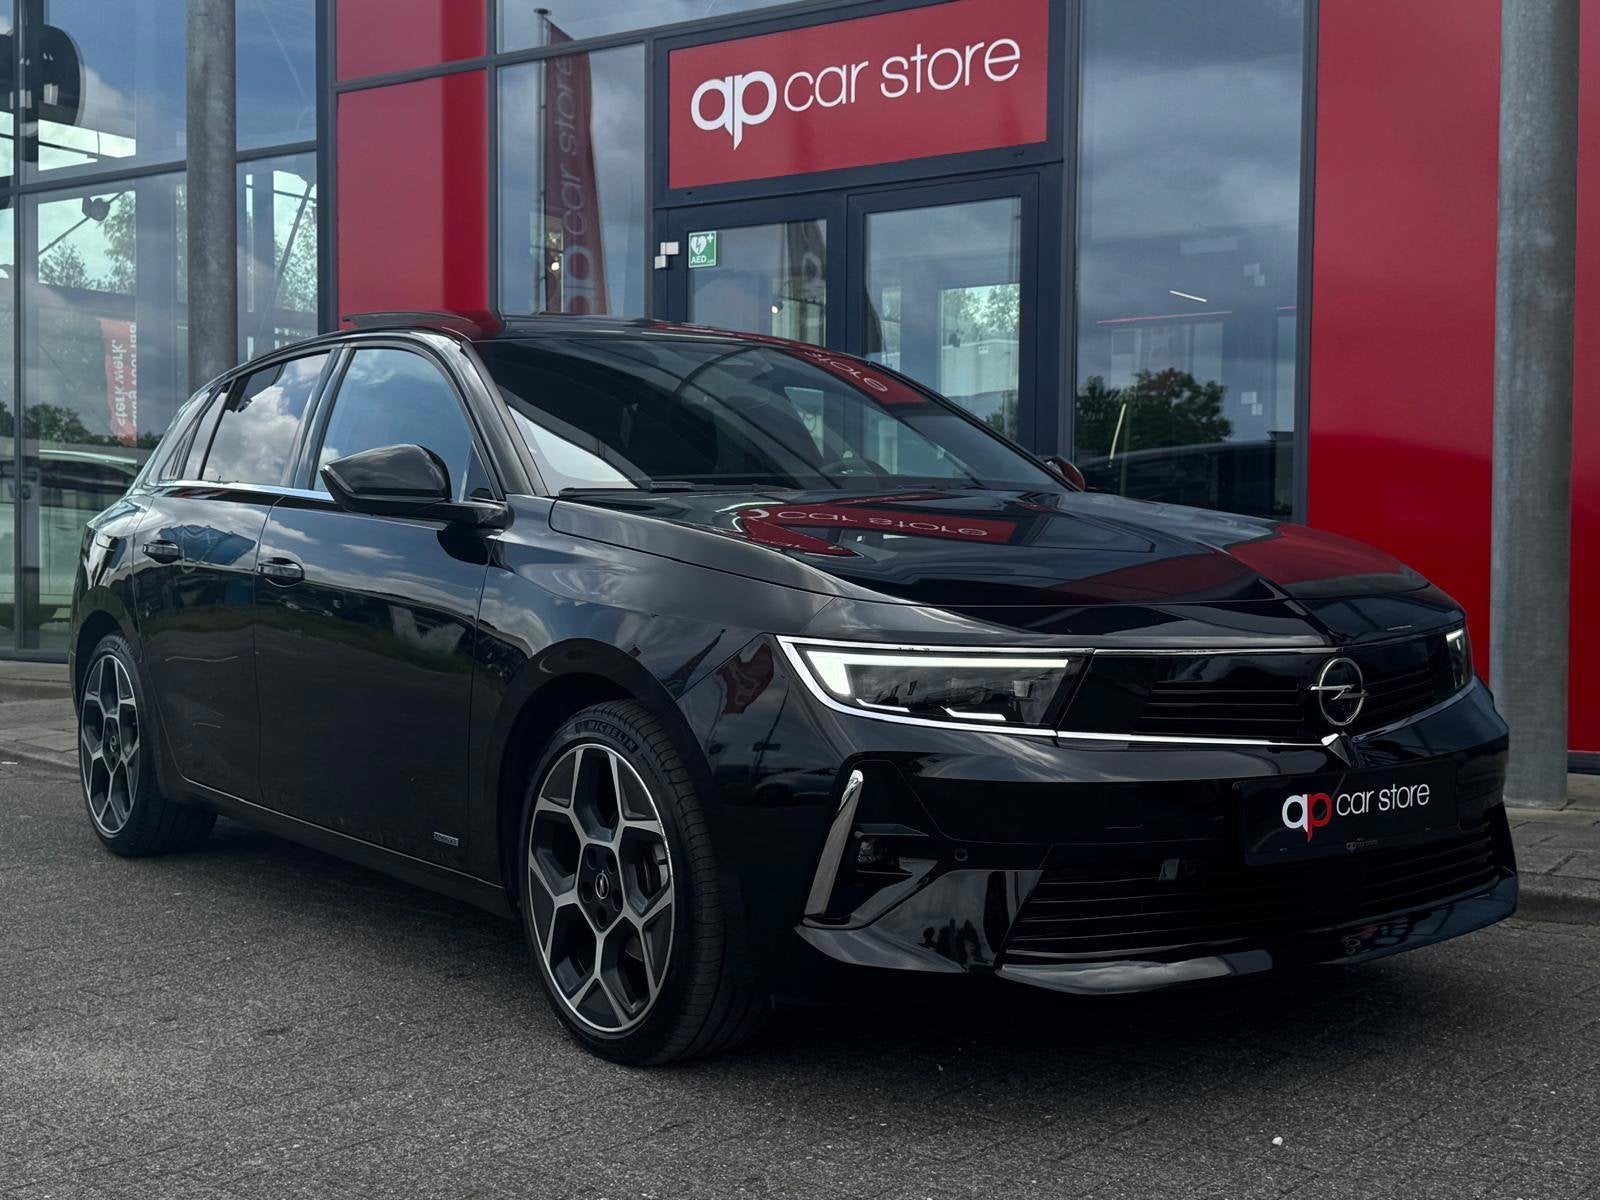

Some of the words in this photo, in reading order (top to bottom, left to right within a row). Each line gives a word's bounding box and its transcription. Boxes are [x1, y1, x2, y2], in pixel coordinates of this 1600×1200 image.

[783, 60, 869, 112] car
[880, 38, 1021, 98] store
[560, 163, 587, 236] car
[690, 255, 707, 264] AED
[1336, 790, 1375, 817] car
[1378, 783, 1430, 812] store
